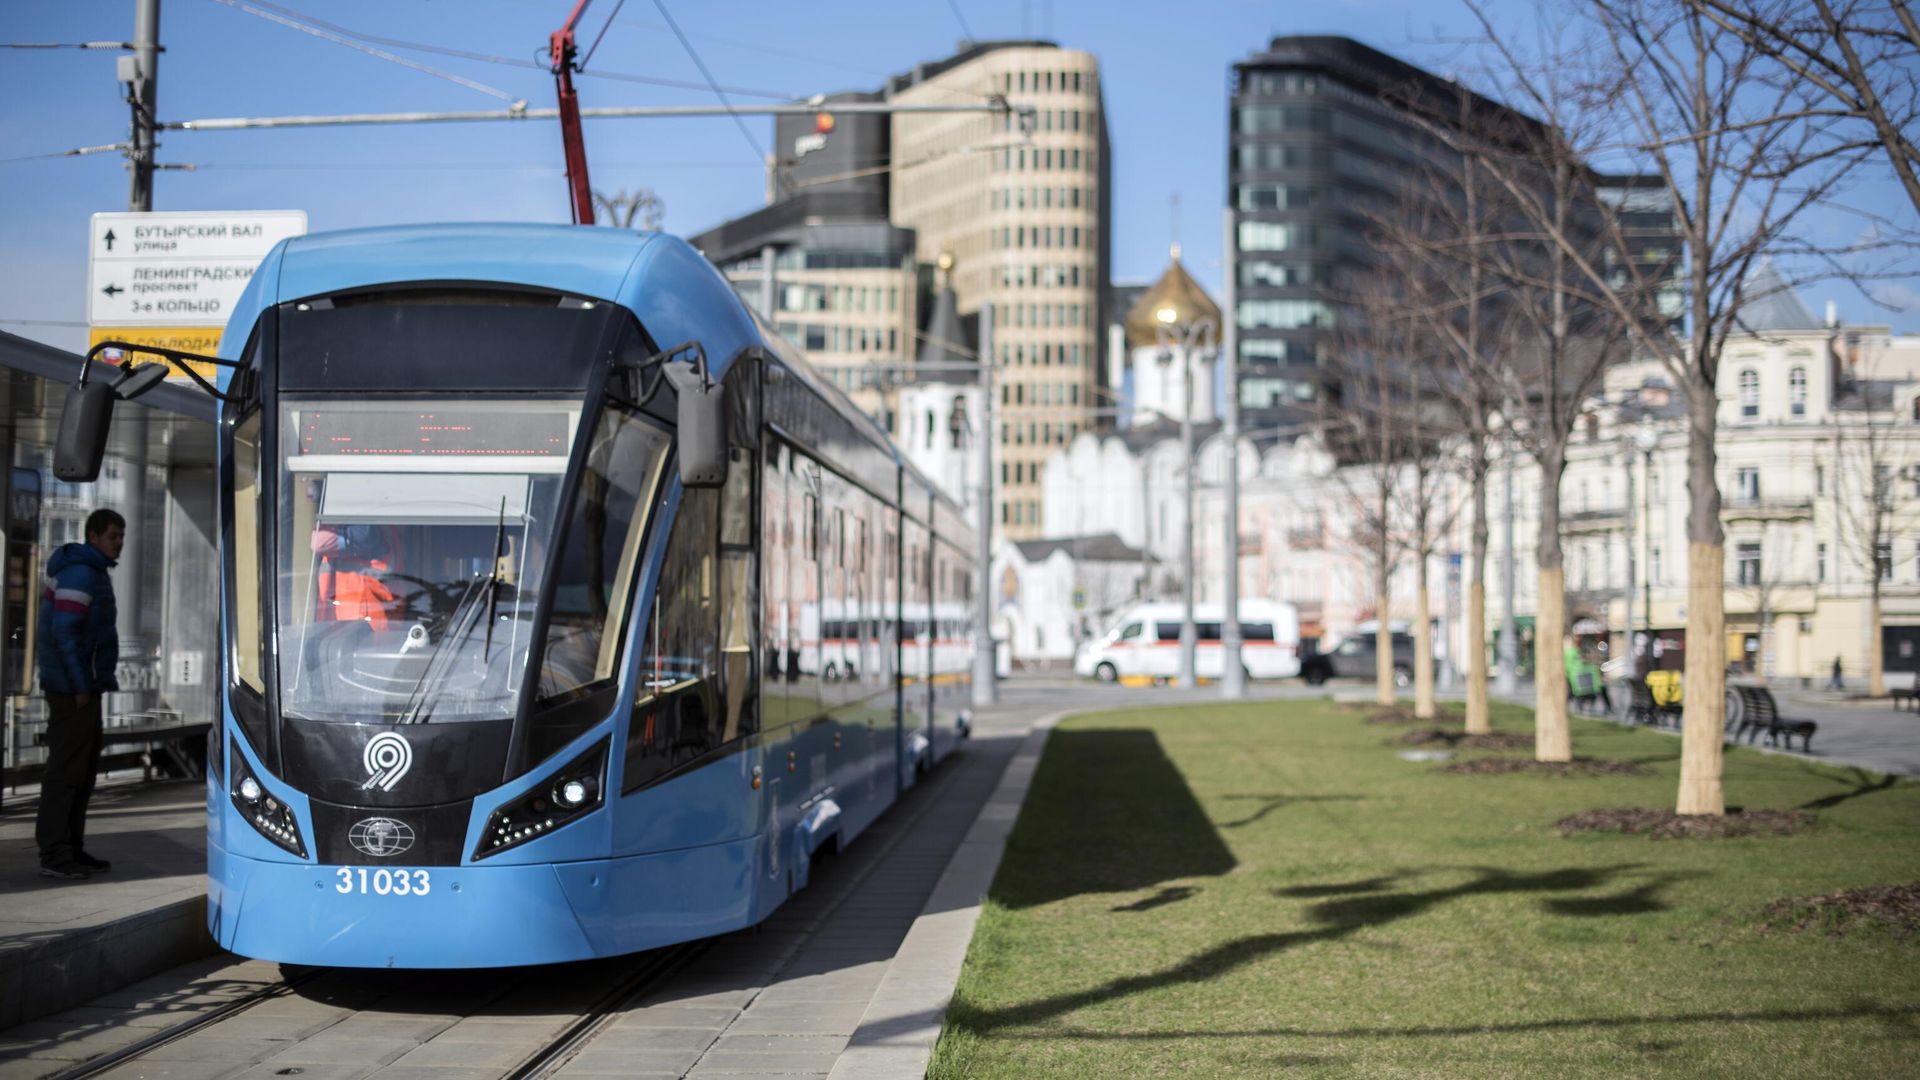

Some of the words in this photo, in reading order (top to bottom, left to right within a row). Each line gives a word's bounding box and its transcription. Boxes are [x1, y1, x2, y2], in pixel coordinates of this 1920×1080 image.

[134, 223, 227, 238] БУТЫРСКИЙ
[231, 223, 263, 238] ВАЛ
[134, 241, 177, 252] улица
[133, 266, 254, 281] ЛЕНИНГРАДСКИ
[132, 283, 198, 295] проспект
[132, 300, 152, 313] 3-е
[158, 300, 220, 314] КОЛЬЦО
[335, 867, 431, 897] 31033
